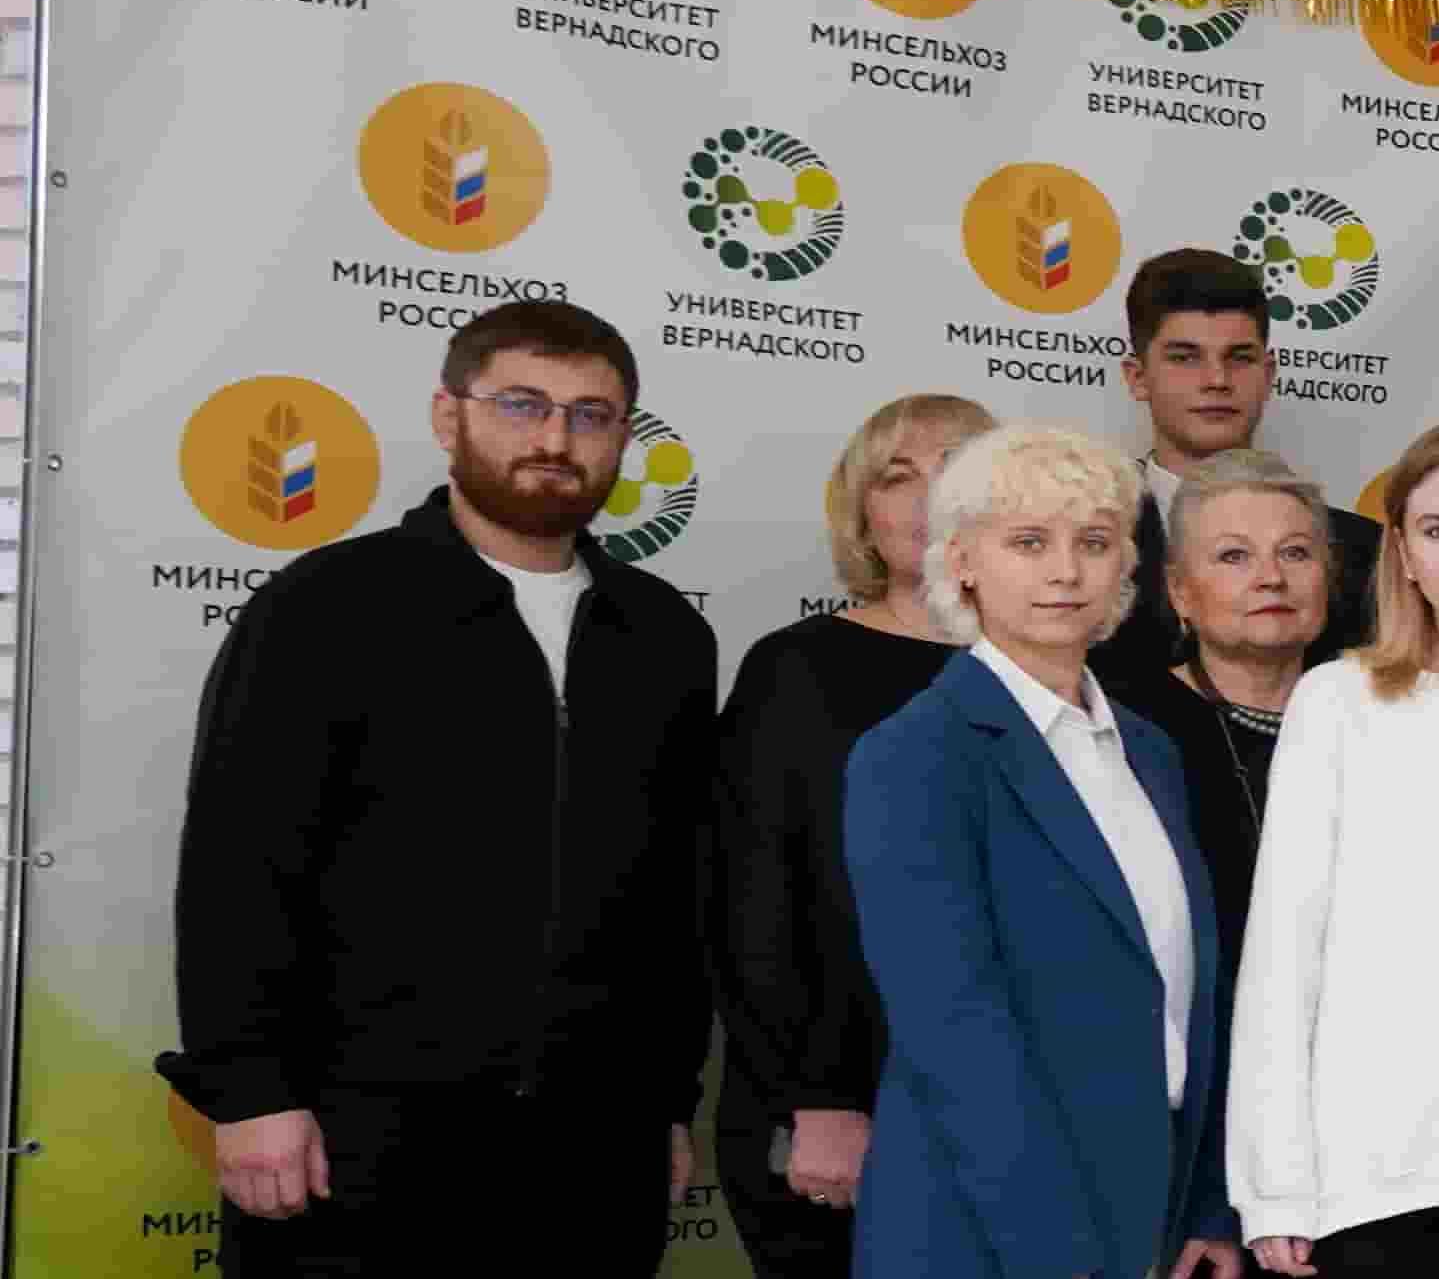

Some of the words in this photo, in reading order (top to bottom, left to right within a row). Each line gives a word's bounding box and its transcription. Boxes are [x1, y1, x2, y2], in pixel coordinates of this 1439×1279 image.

[516, 7, 720, 61] ВЕРНАДСКОГО
[810, 23, 1007, 71] МИНСЕЛЬХОЗ
[851, 62, 971, 97] РОССИИ
[1088, 62, 1264, 101] УНИВЕРСИТЕТ
[1088, 93, 1266, 131] ВЕРНАДСКОГО
[379, 301, 470, 329] РОСС
[666, 291, 864, 331] УНИВЕРСИТЕТ
[663, 325, 864, 364] ВЕРНАДСКОГО
[948, 323, 1132, 356] МИНСЕЛЬХО
[987, 358, 1105, 387] РОССИИ
